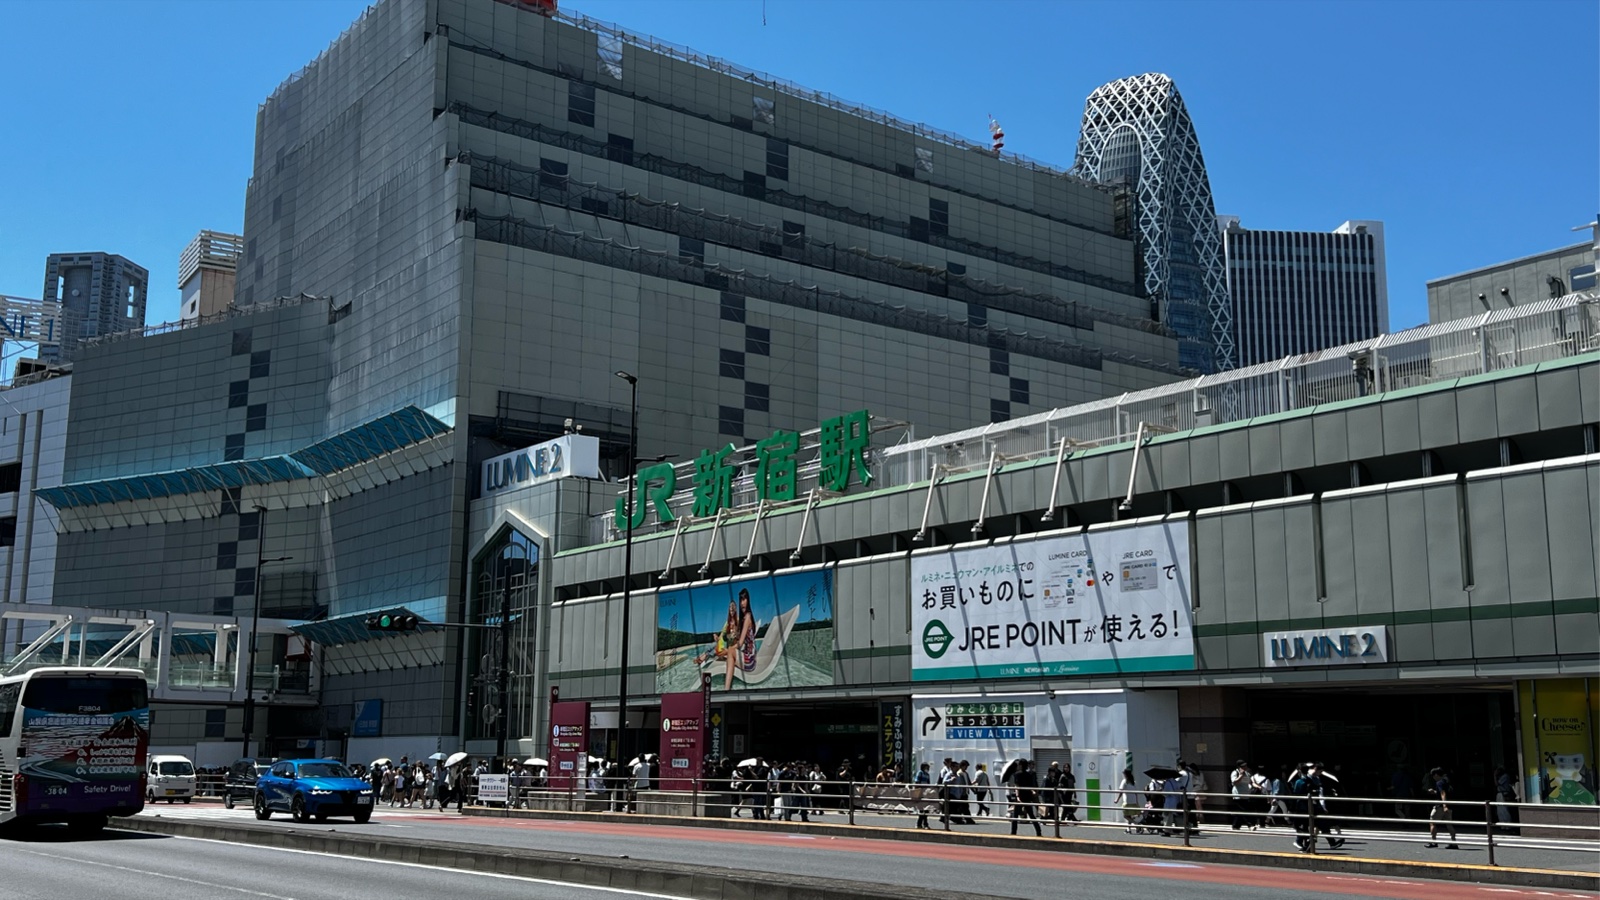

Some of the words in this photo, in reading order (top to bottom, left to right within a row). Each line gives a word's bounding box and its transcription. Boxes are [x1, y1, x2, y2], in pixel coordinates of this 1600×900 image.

[1186, 335, 1200, 344] HAL
[486, 447, 548, 491] LUMINE
[549, 443, 563, 474] 2
[615, 409, 874, 530] JR新宿駅
[1048, 552, 1070, 561] LUMINE
[1070, 550, 1088, 558] CARD
[1122, 551, 1134, 560] JRE
[1135, 549, 1153, 558] CARD
[920, 561, 1034, 583] ルミネ・ニュウマン・アイルミネでの
[1102, 571, 1114, 586] や
[1163, 564, 1177, 581] で
[921, 578, 1035, 610] お買いものに
[958, 624, 1000, 651] JRE
[1270, 634, 1358, 661] LUMINE
[1361, 632, 1377, 656] 2
[1000, 667, 1020, 675] LUMINE
[957, 703, 1021, 713] みどりの窓口
[957, 716, 1021, 726] きっぷうりば
[957, 730, 983, 738] VIEW
[988, 729, 1021, 738] ALTTE
[84, 785, 108, 794] Safety
[110, 784, 131, 792] Drive!
